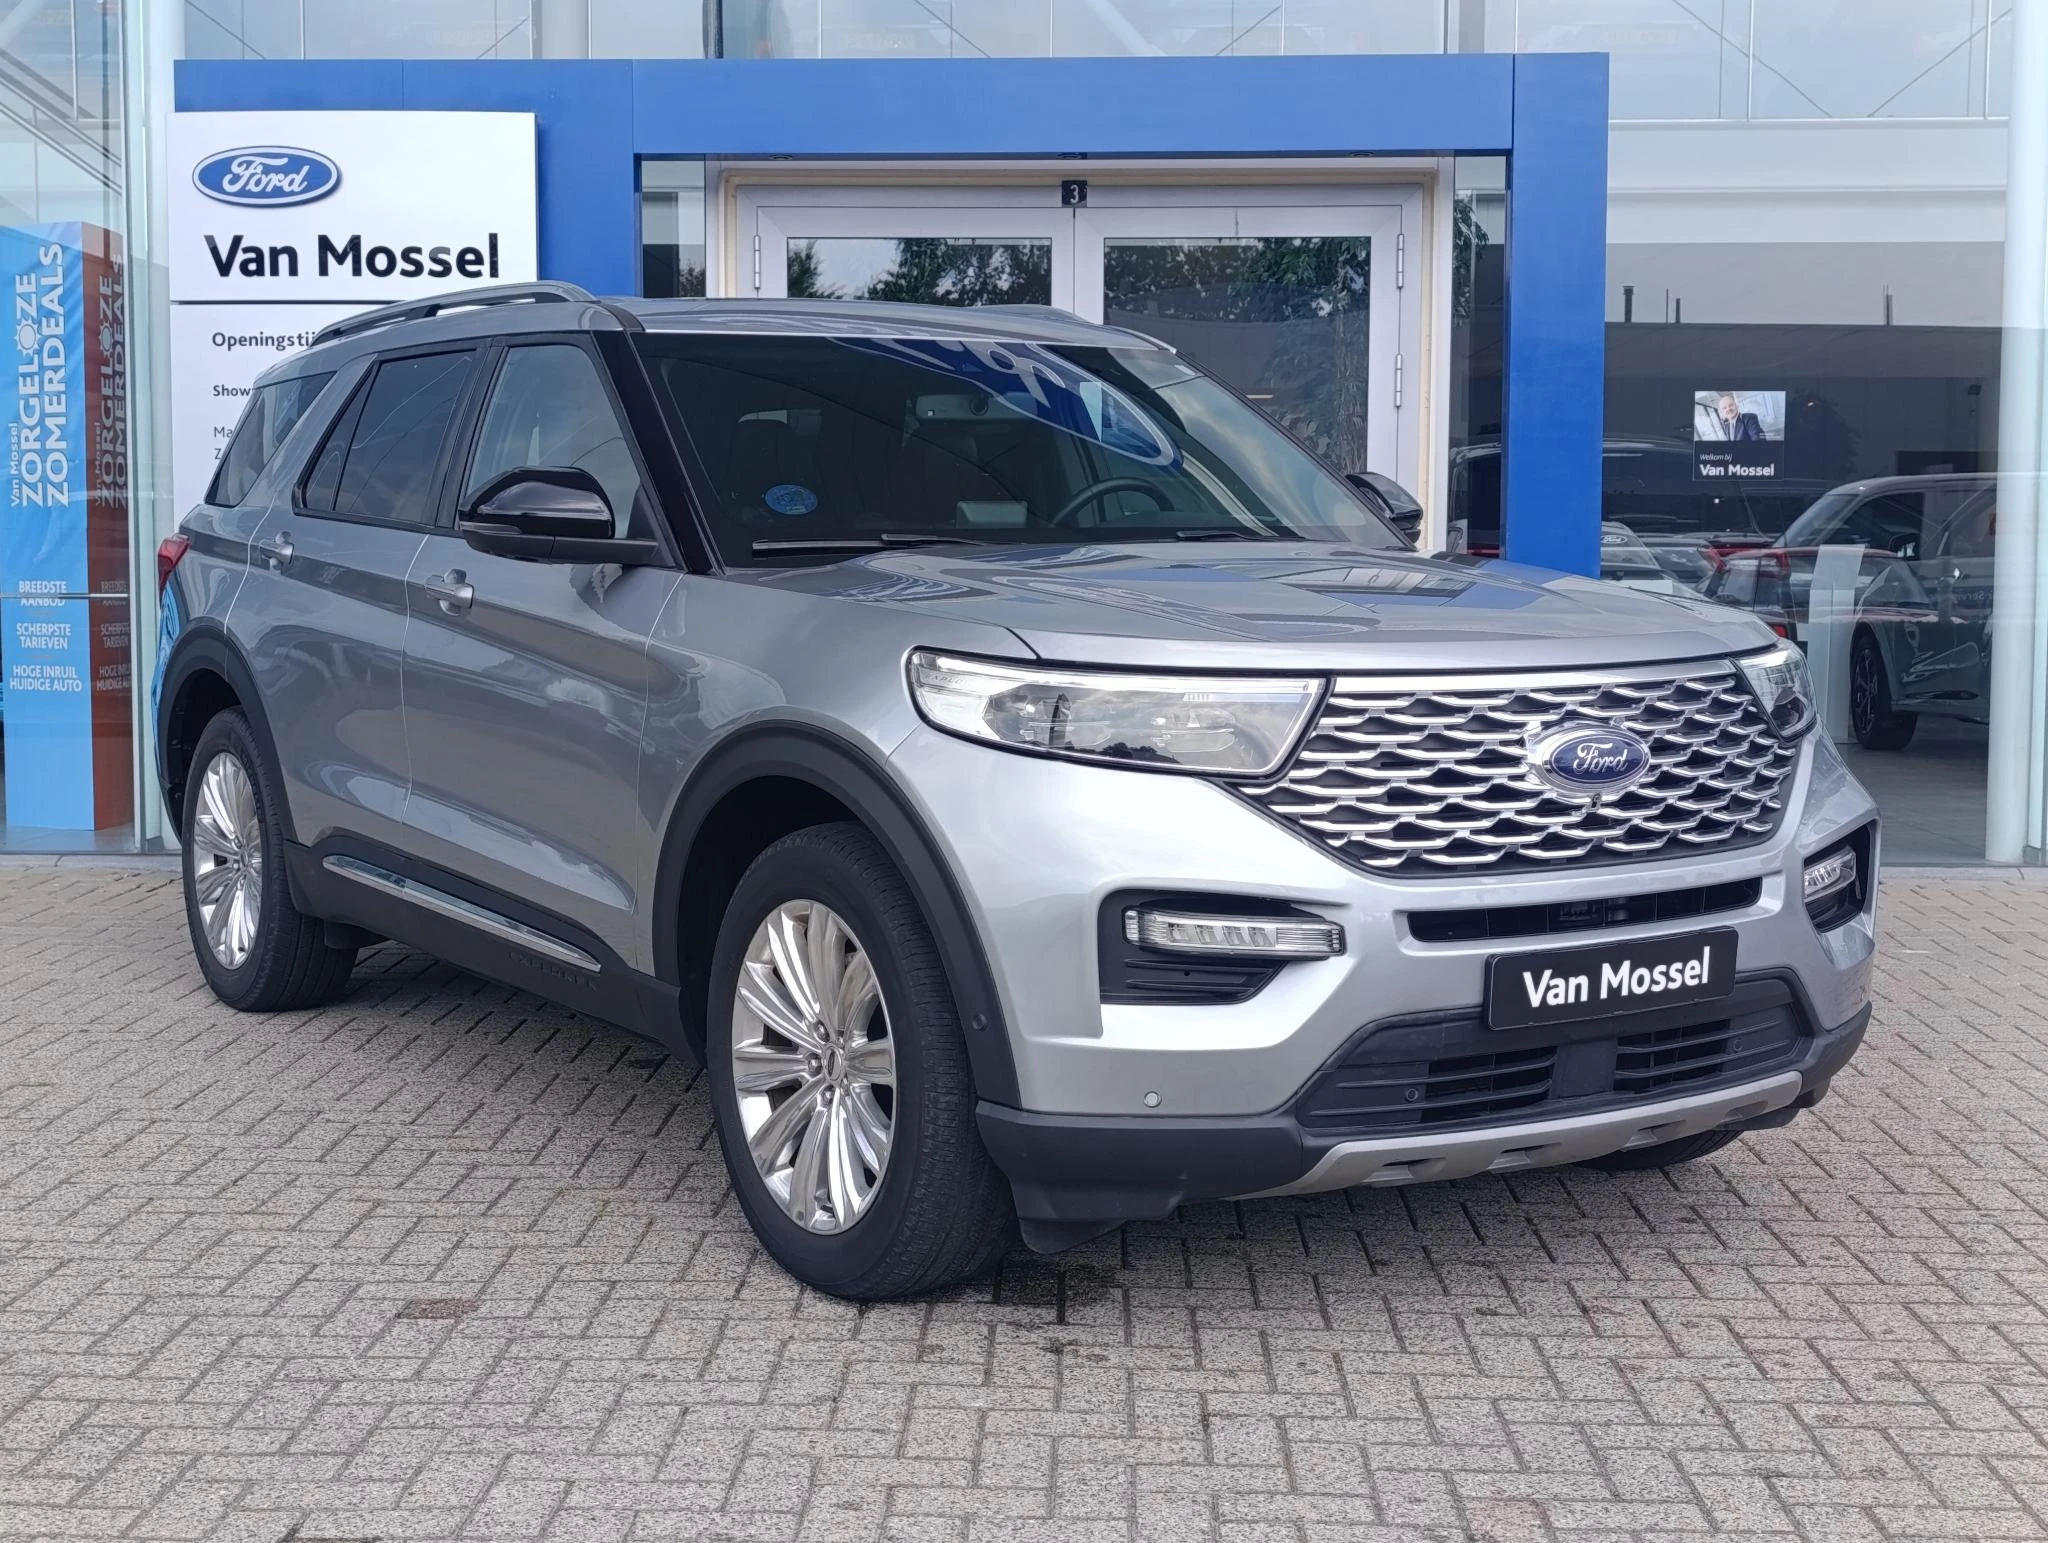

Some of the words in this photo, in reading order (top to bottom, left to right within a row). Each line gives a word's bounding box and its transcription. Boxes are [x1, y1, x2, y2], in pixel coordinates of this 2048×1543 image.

[222, 155, 310, 193] Ford
[1070, 184, 1079, 203] 3
[203, 234, 299, 277] Van
[317, 232, 499, 279] Mossel
[40, 243, 69, 507] ZOMERDEALS
[213, 384, 251, 397] Show
[9, 423, 19, 474] Mossel
[1699, 464, 1725, 476] Van
[1728, 463, 1774, 476] Mossel
[10, 479, 19, 507] Van
[18, 581, 67, 593] BREEDSTE
[16, 623, 72, 636] SCHERPSTE
[19, 636, 68, 649] TARIEVEN
[13, 665, 41, 678] HOGE
[43, 665, 78, 679] INRUIL
[9, 677, 51, 691] HUIDIGE
[52, 679, 82, 692] AUTO
[1573, 742, 1628, 774] Ford
[1522, 969, 1589, 1008] Van
[1600, 945, 1711, 1000] Mossel
